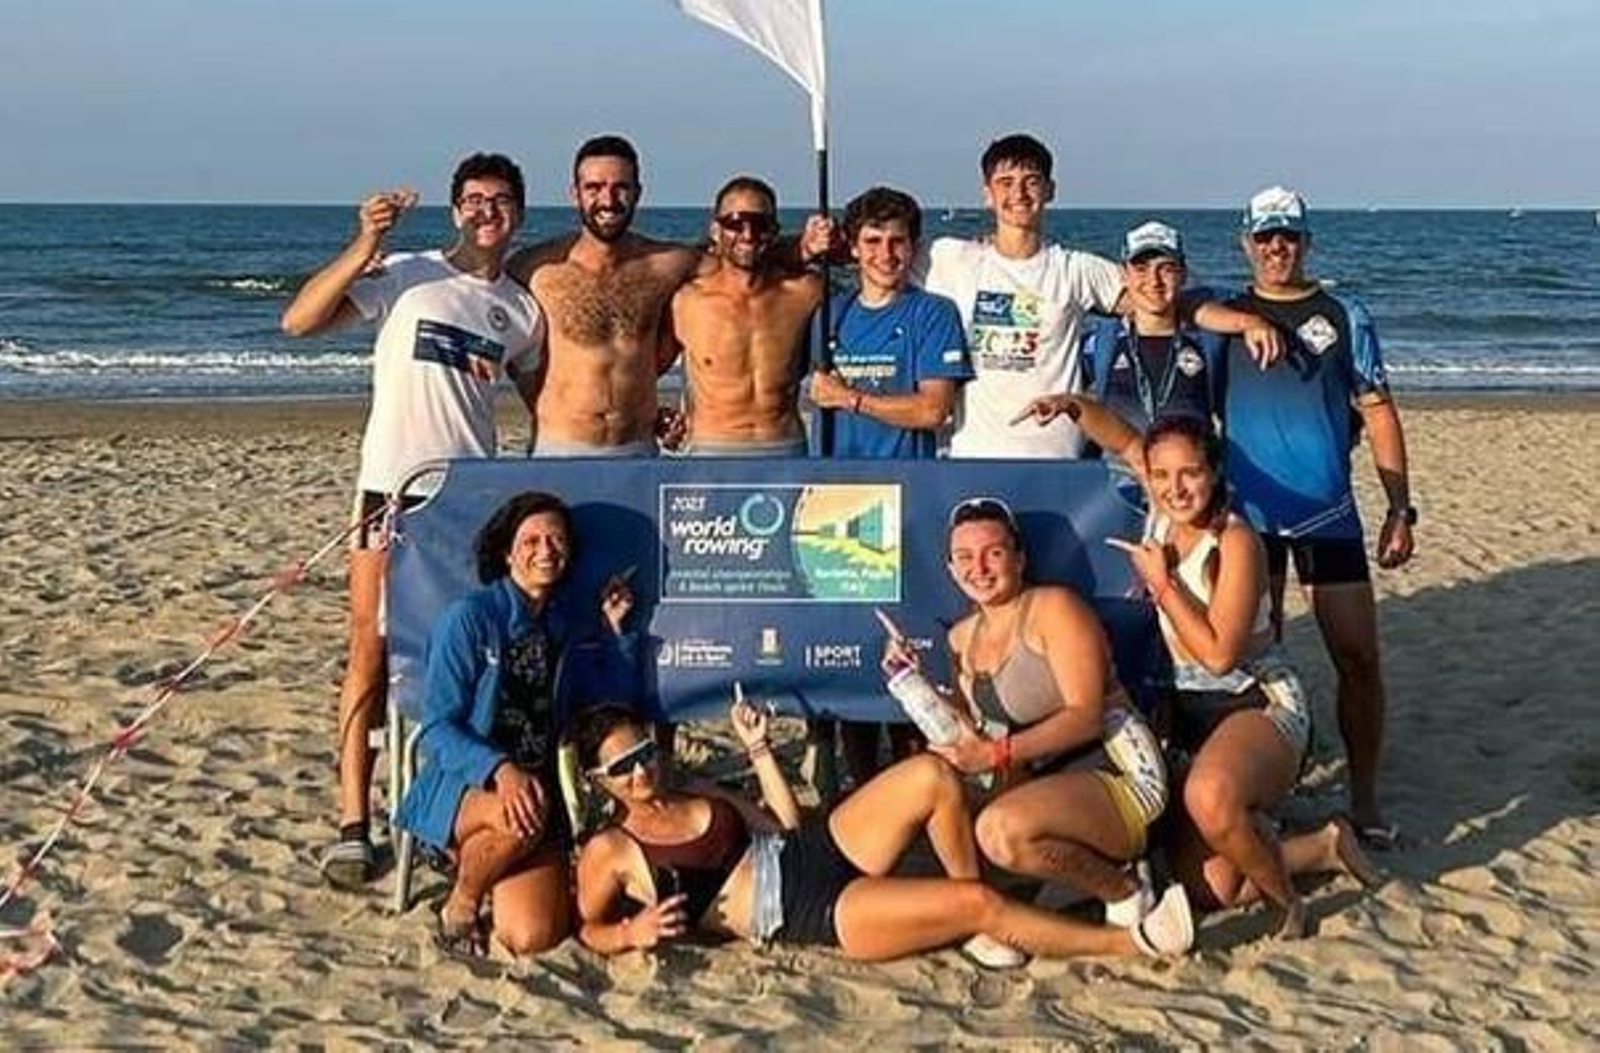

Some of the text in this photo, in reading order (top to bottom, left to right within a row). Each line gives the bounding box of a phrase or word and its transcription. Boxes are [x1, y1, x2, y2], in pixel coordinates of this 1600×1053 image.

[671, 515, 738, 537] world
[683, 536, 767, 560] rowing
[813, 645, 861, 658] SPORT
